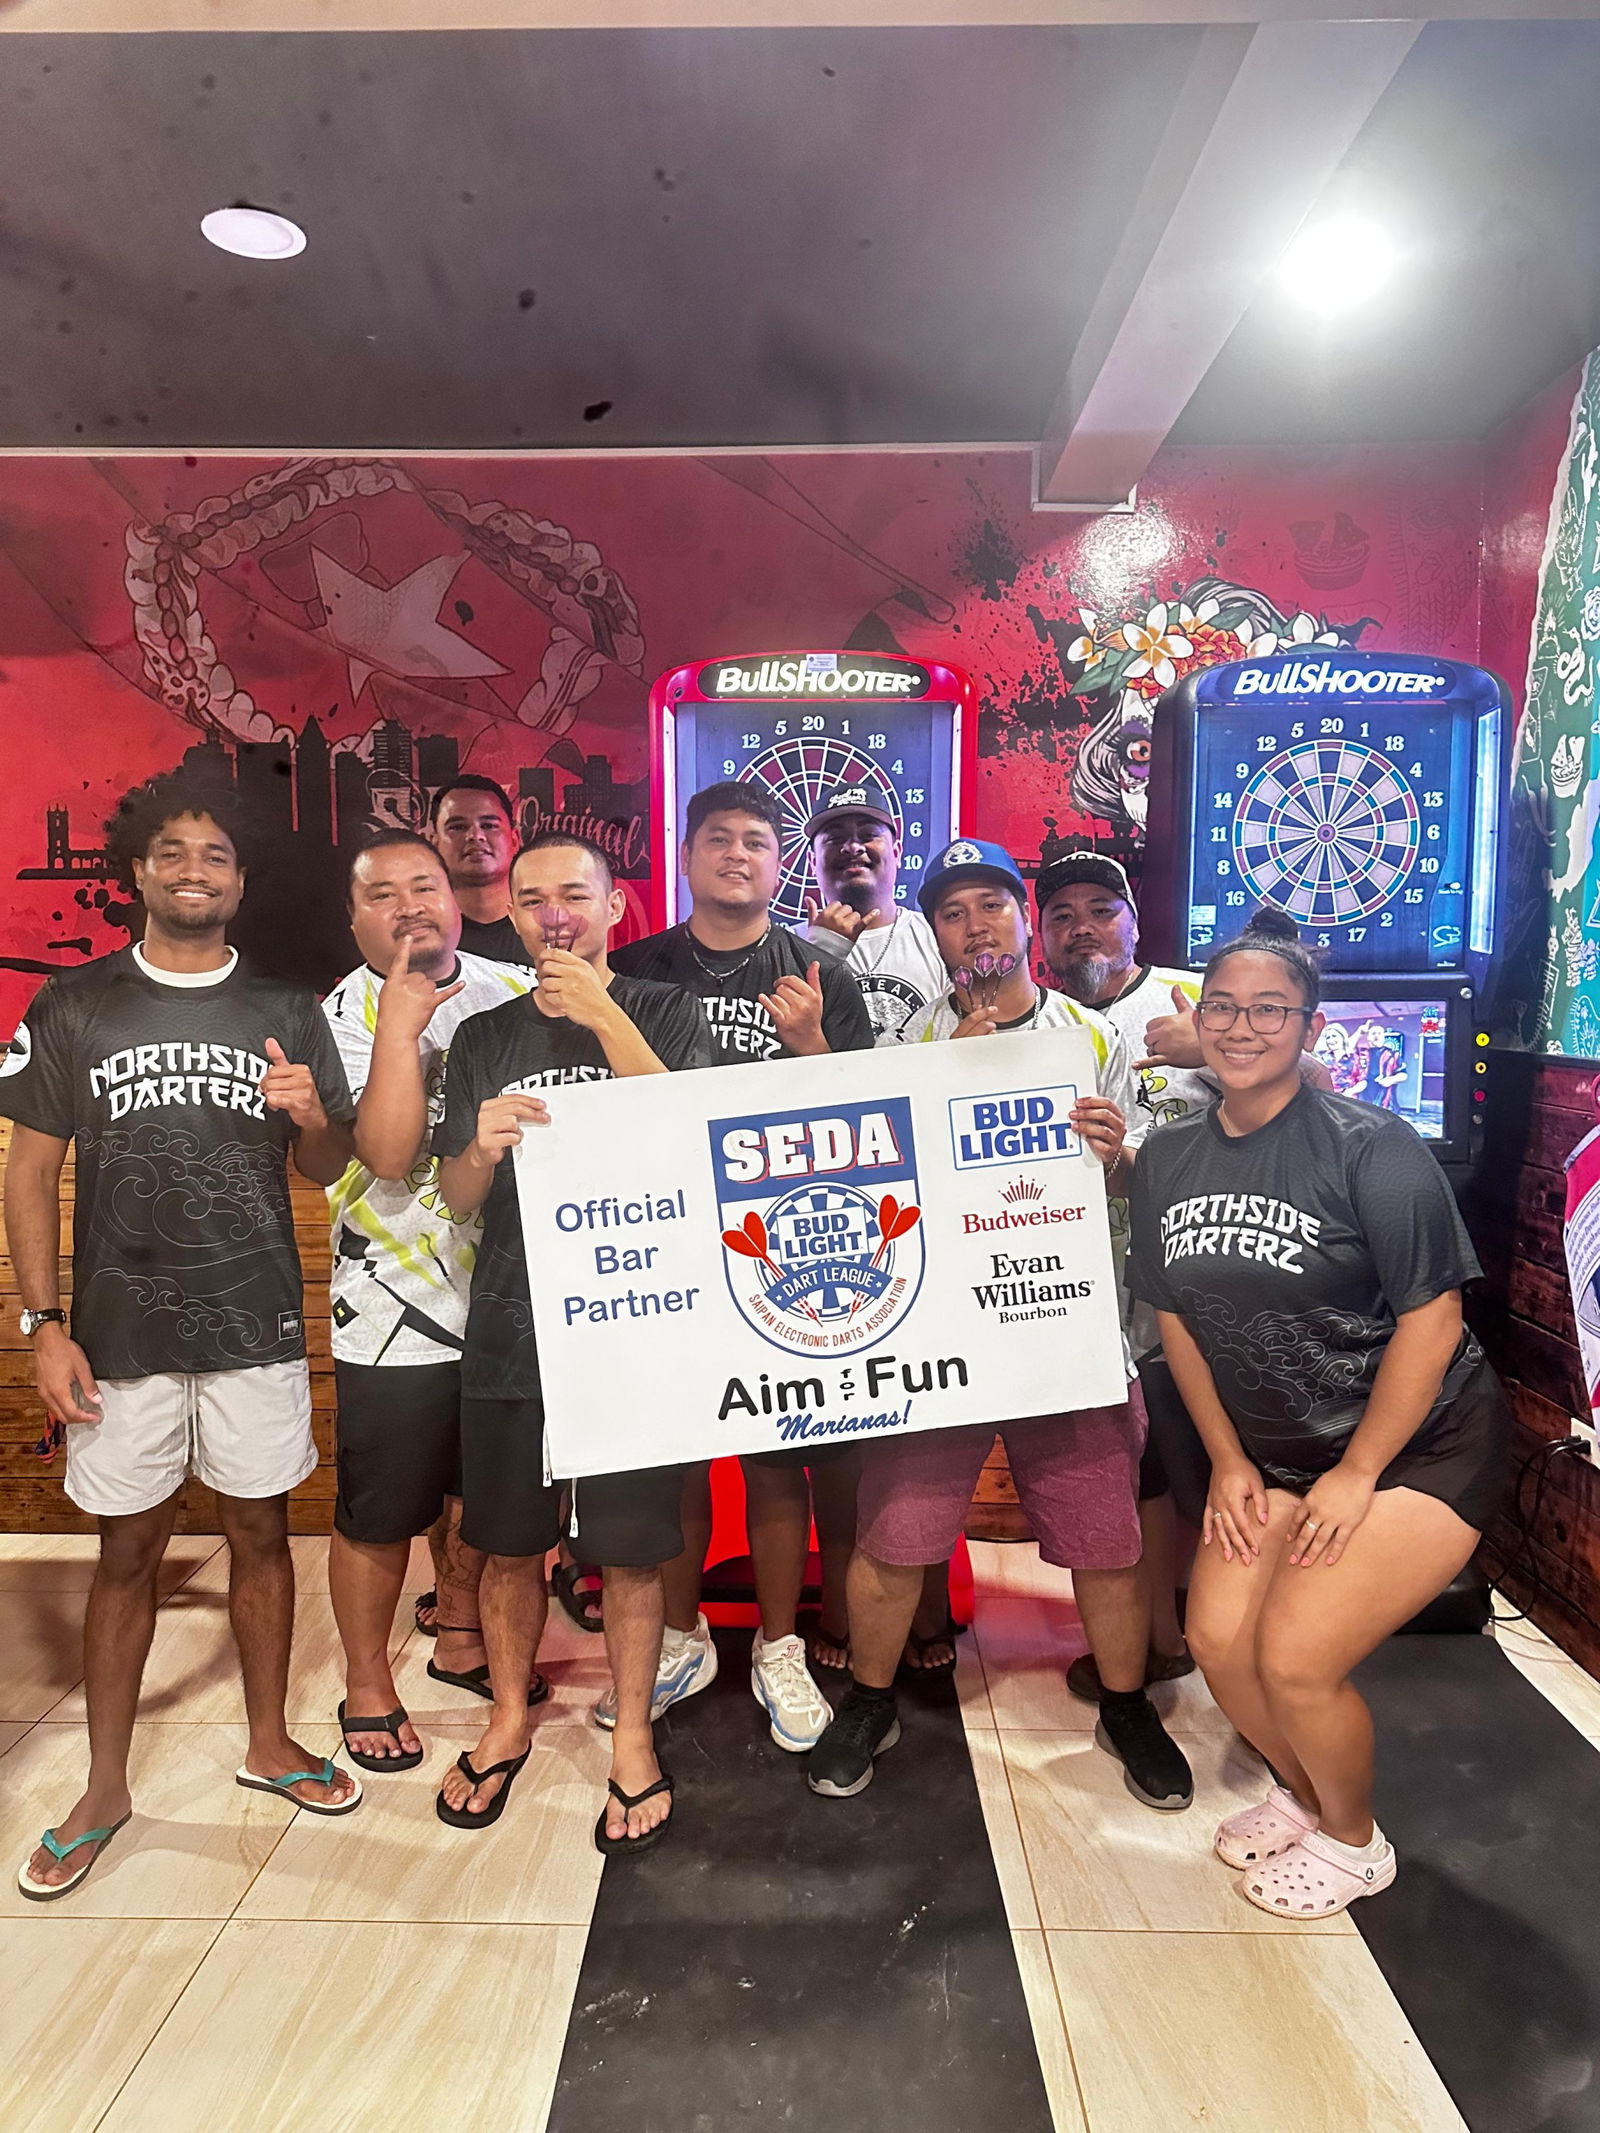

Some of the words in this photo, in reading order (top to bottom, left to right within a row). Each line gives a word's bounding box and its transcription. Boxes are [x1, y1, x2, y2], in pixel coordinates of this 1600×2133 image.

[775, 721, 787, 735] 5
[802, 716, 824, 731] 20
[842, 720, 850, 734] 1
[1291, 723, 1304, 738] 5
[1320, 718, 1343, 733] 20
[1360, 723, 1369, 737] 1
[742, 735, 761, 749] 12
[868, 735, 886, 749] 18
[1257, 737, 1277, 751] 12
[1385, 737, 1404, 751] 18
[724, 760, 736, 774] 9
[891, 760, 904, 774] 4
[1236, 764, 1249, 778] 9
[1409, 763, 1422, 777] 4
[905, 789, 924, 803] 13
[1213, 793, 1232, 808] 14
[1423, 792, 1444, 807] 13
[910, 822, 922, 837] 6
[1211, 827, 1227, 841] 11
[1427, 825, 1440, 840] 6
[904, 855, 922, 869] 10
[1217, 860, 1230, 875] 8
[1420, 858, 1439, 873] 10
[1225, 891, 1245, 906] 16
[1404, 889, 1424, 904] 15
[1380, 913, 1393, 927] 2
[1317, 933, 1330, 947] 3
[1348, 928, 1367, 942] 17
[89, 1042, 275, 1098] NORTHSID
[108, 1075, 266, 1121] DARTERZ
[973, 1096, 1054, 1131] BUD
[722, 1112, 904, 1184] SEDA
[960, 1122, 1072, 1162] LIGHT
[555, 1189, 686, 1232] Official
[793, 1213, 850, 1237] BUD
[961, 1205, 1087, 1234] Budweiser
[1161, 1194, 1321, 1247] NORTHSIDE
[784, 1231, 862, 1259] LIGHT
[1164, 1226, 1304, 1274] DARTERZ
[594, 1245, 659, 1275] Bar
[990, 1253, 1064, 1279] Evan
[782, 1269, 820, 1298] DART
[824, 1267, 876, 1288] LEAGUE
[971, 1280, 1091, 1310] Williams
[564, 1288, 700, 1326] Partner
[749, 1294, 774, 1327] SAIPAN
[774, 1321, 829, 1348] ELECTRONIC
[832, 1326, 865, 1347] DARTS
[866, 1276, 907, 1332] ASSOCIATION
[999, 1306, 1067, 1324] Bourbon
[718, 1373, 825, 1421] Aim
[866, 1355, 968, 1398] Fun
[777, 1399, 912, 1441] Marianas!
